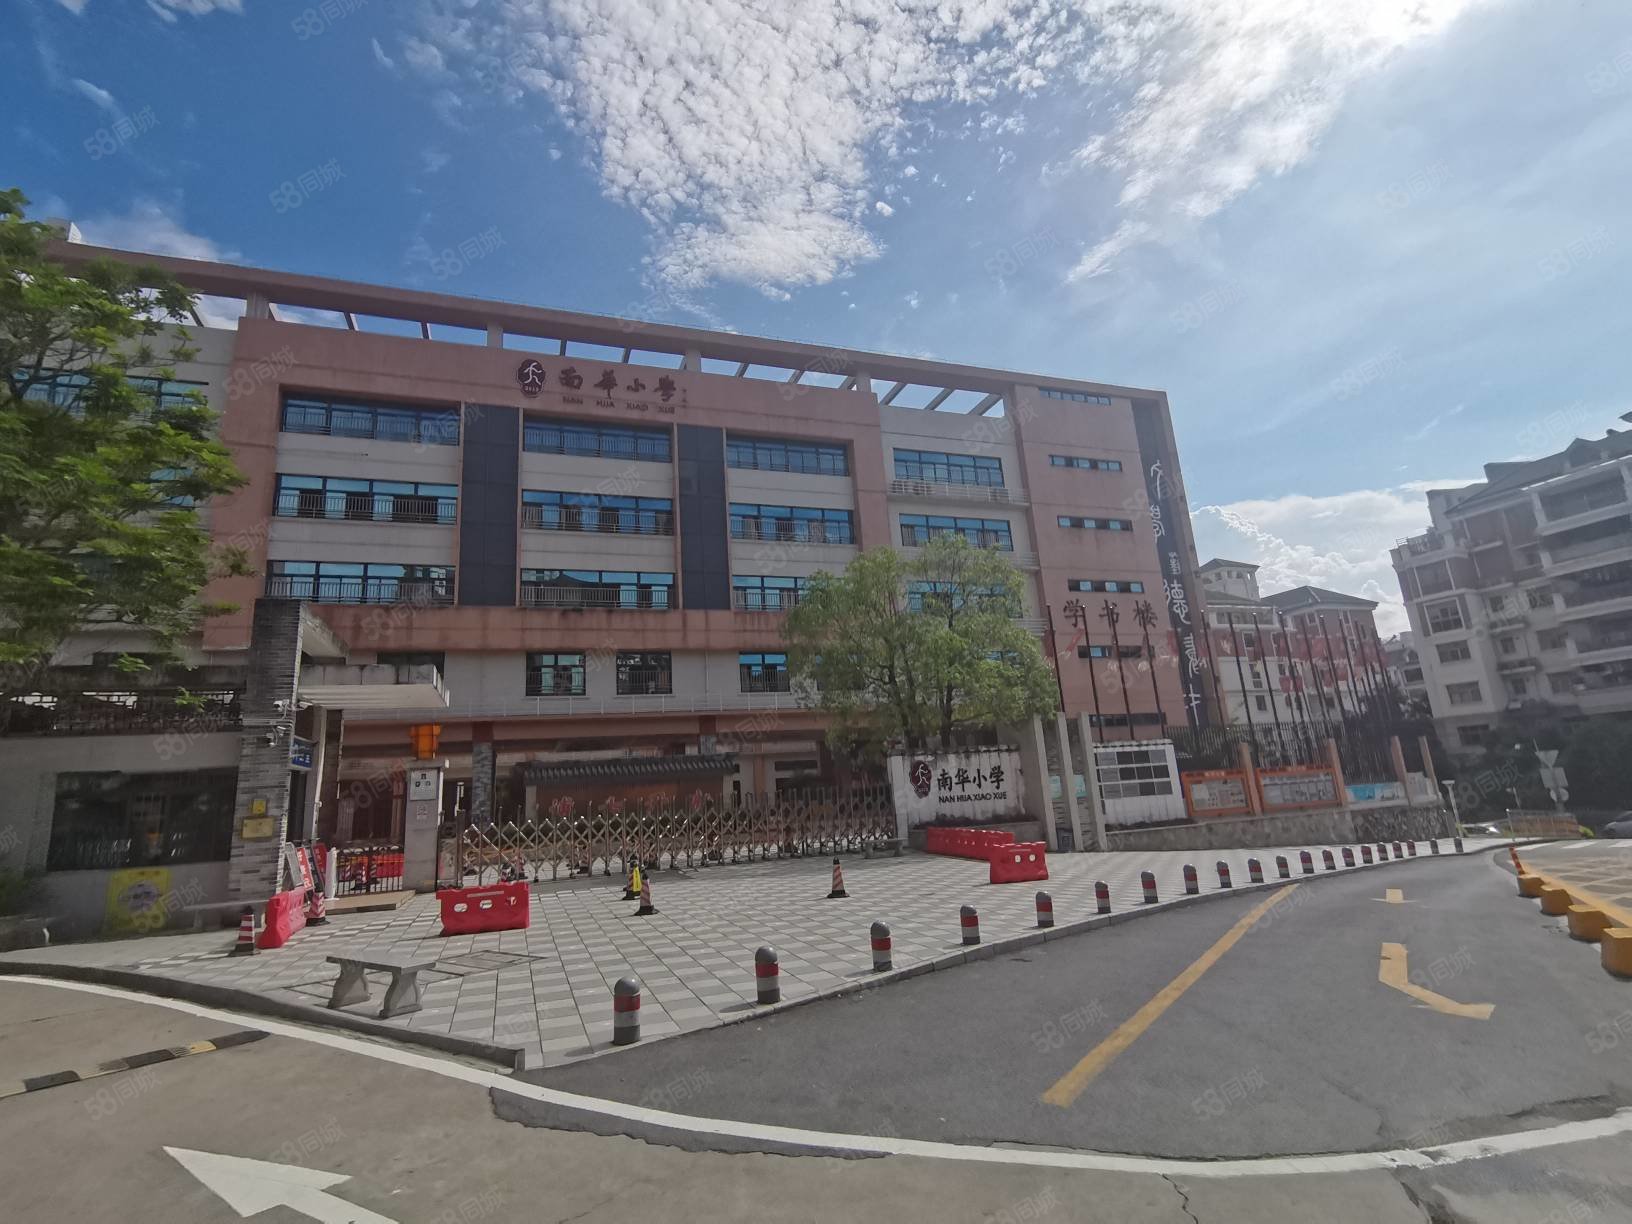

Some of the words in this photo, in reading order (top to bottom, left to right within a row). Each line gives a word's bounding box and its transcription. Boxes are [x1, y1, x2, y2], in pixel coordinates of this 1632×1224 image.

[937, 765, 1005, 793] 南华小学
[938, 795, 955, 804] NAN
[957, 793, 972, 803] HUA
[972, 792, 992, 801] XIAO
[993, 790, 1007, 800] XUE
